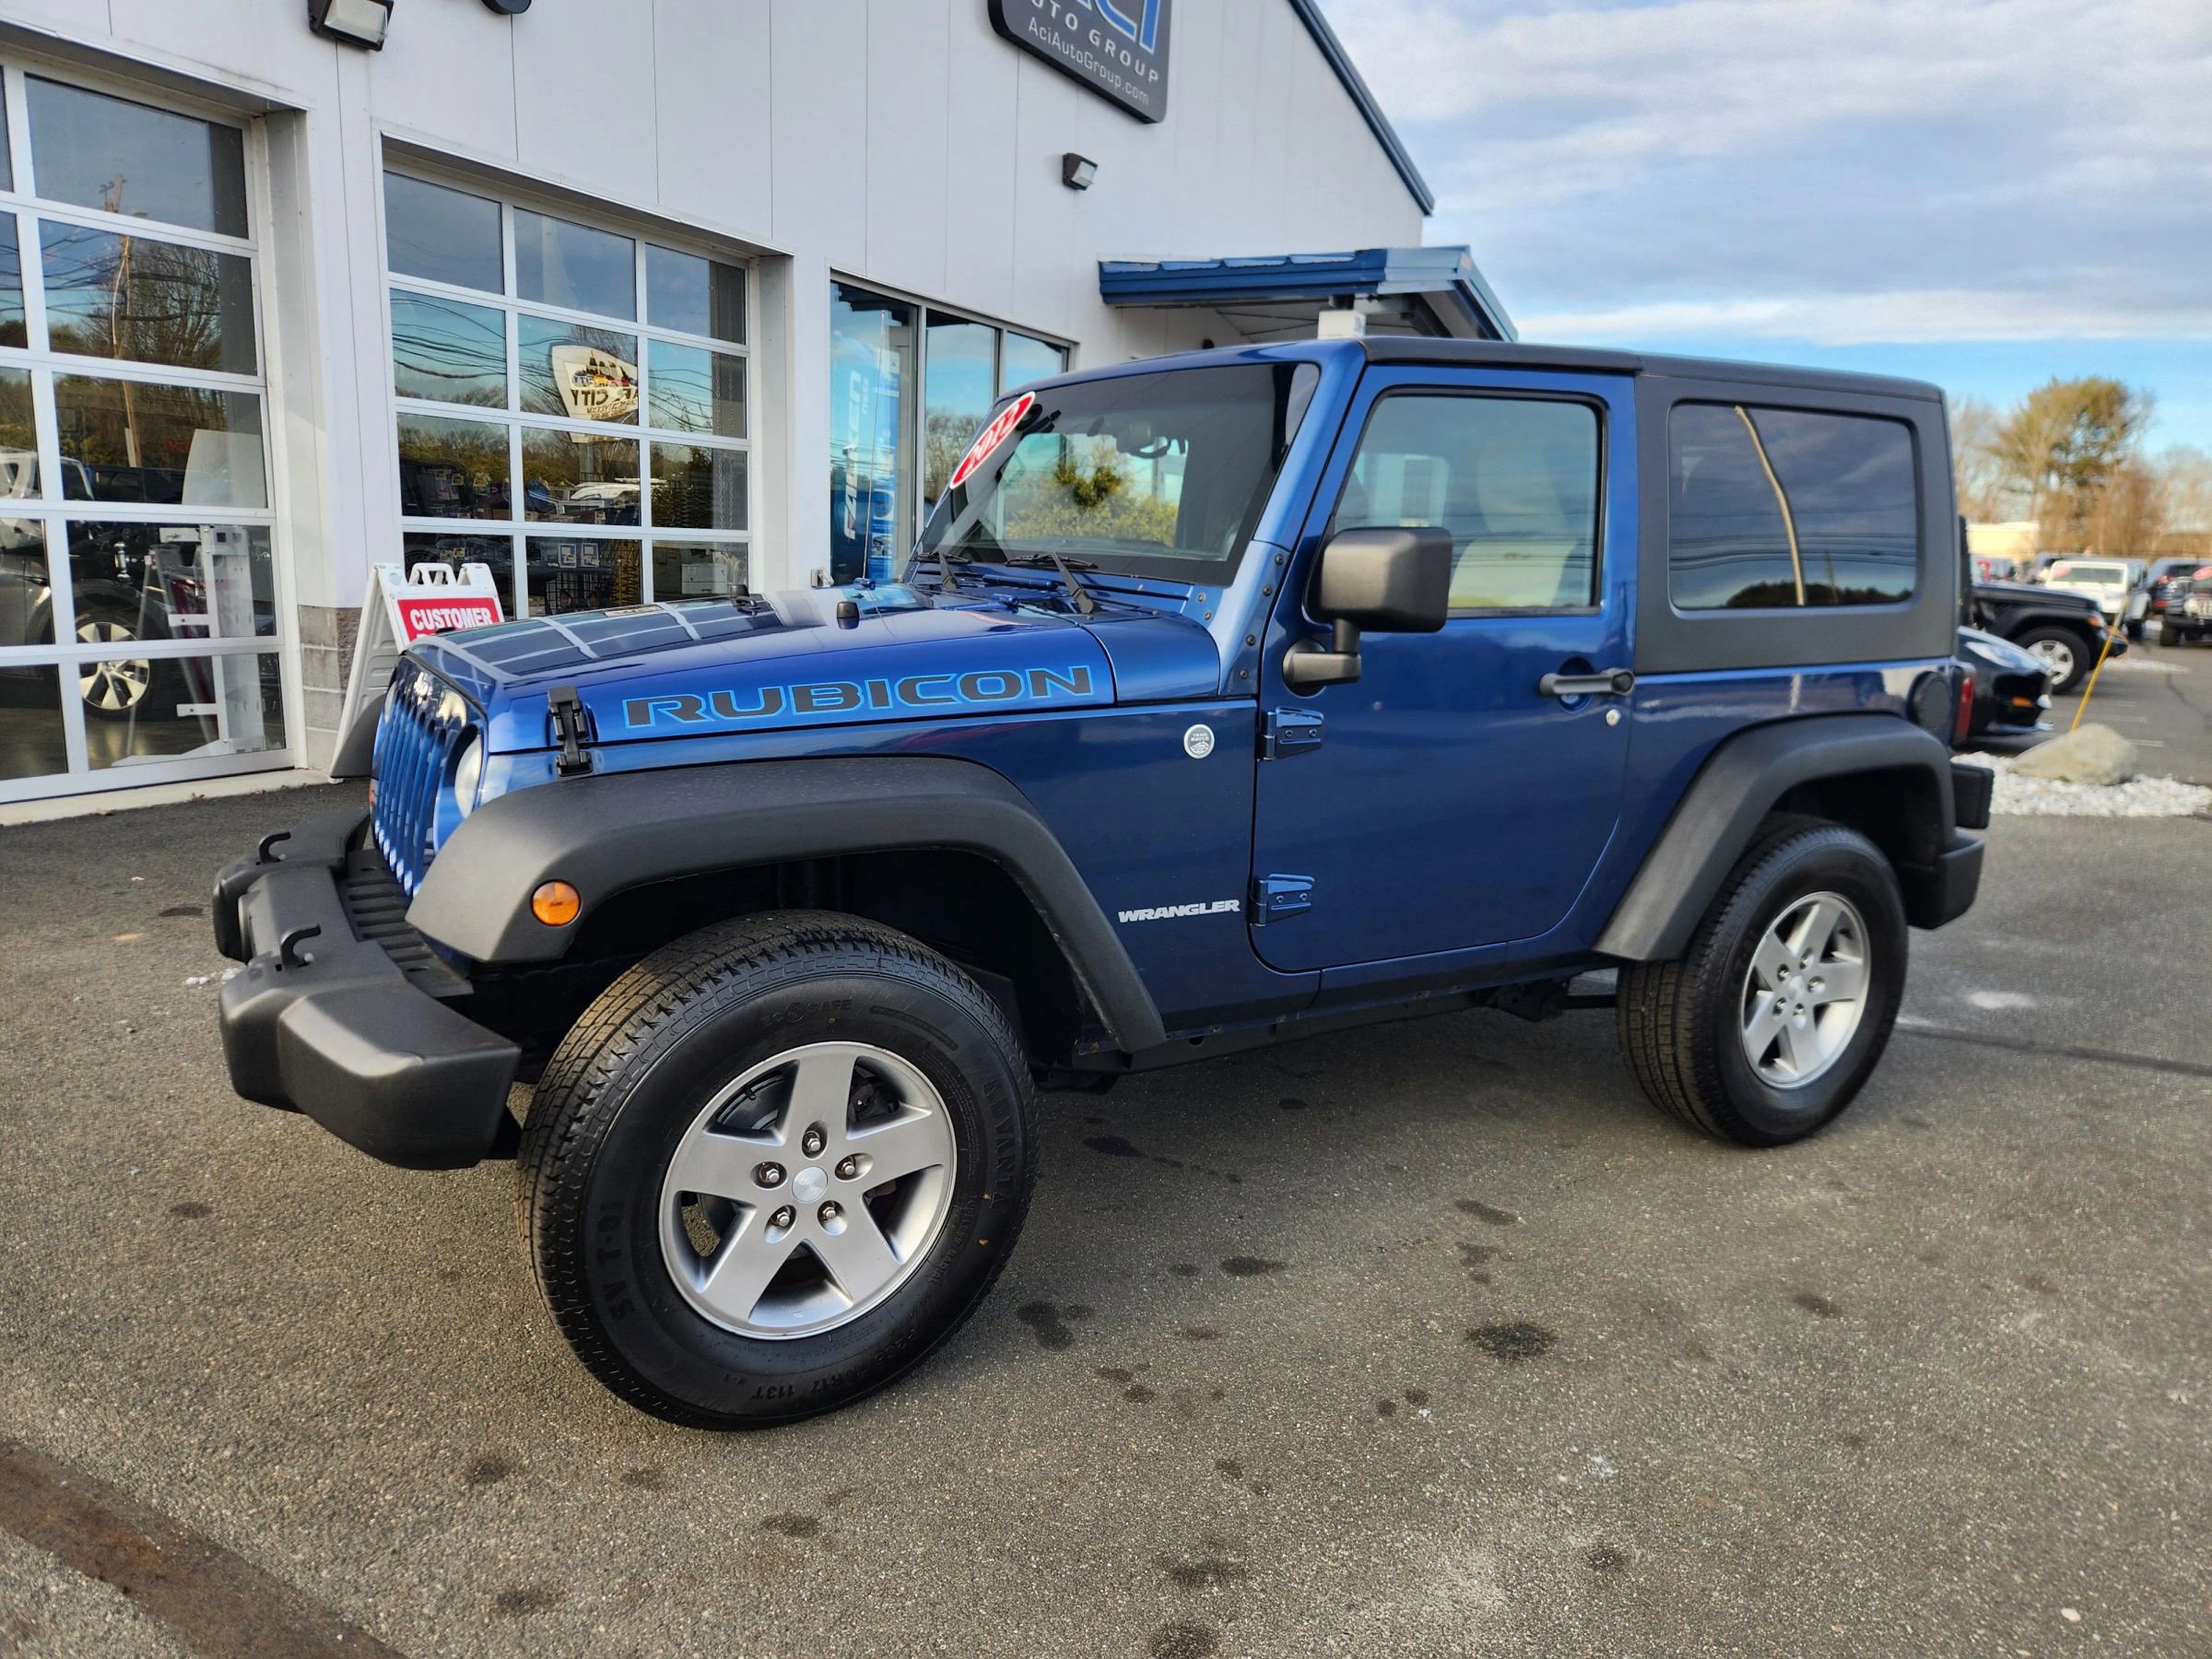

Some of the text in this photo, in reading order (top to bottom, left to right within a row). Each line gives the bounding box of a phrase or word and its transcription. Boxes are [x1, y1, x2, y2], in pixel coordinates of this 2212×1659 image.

[1027, 16, 1150, 106] AciAutoGroup.com
[1088, 29, 1159, 84] GROUP
[409, 606, 494, 631] CUSTOMER
[621, 665, 1095, 728] RUBICON
[1118, 899, 1241, 924] WRANGLER
[750, 1384, 796, 1400] 113T
